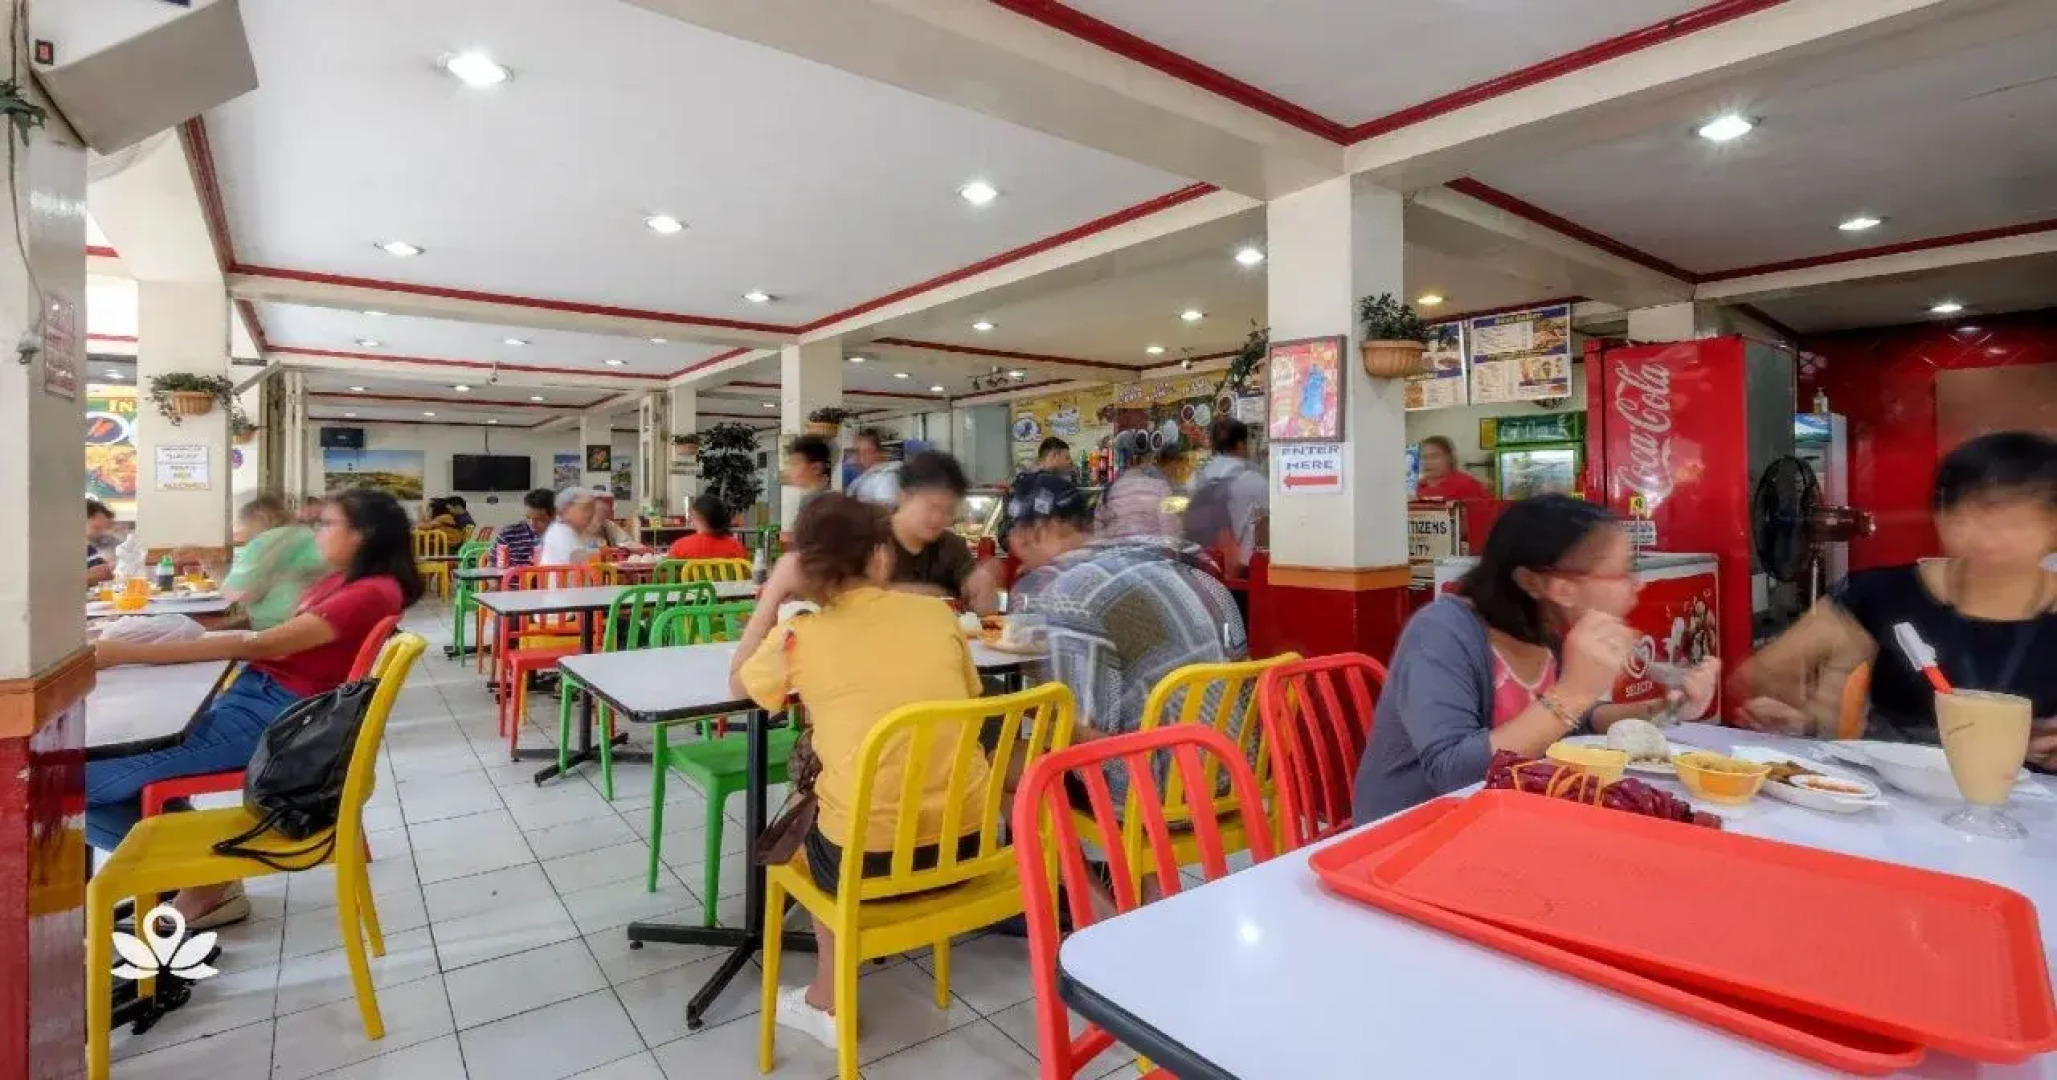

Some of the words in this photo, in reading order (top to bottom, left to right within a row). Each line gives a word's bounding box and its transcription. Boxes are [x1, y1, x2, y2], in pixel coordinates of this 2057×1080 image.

[1281, 445, 1340, 456] ENTER
[1286, 460, 1334, 470] HERE
[1408, 520, 1448, 534] TIZENS
